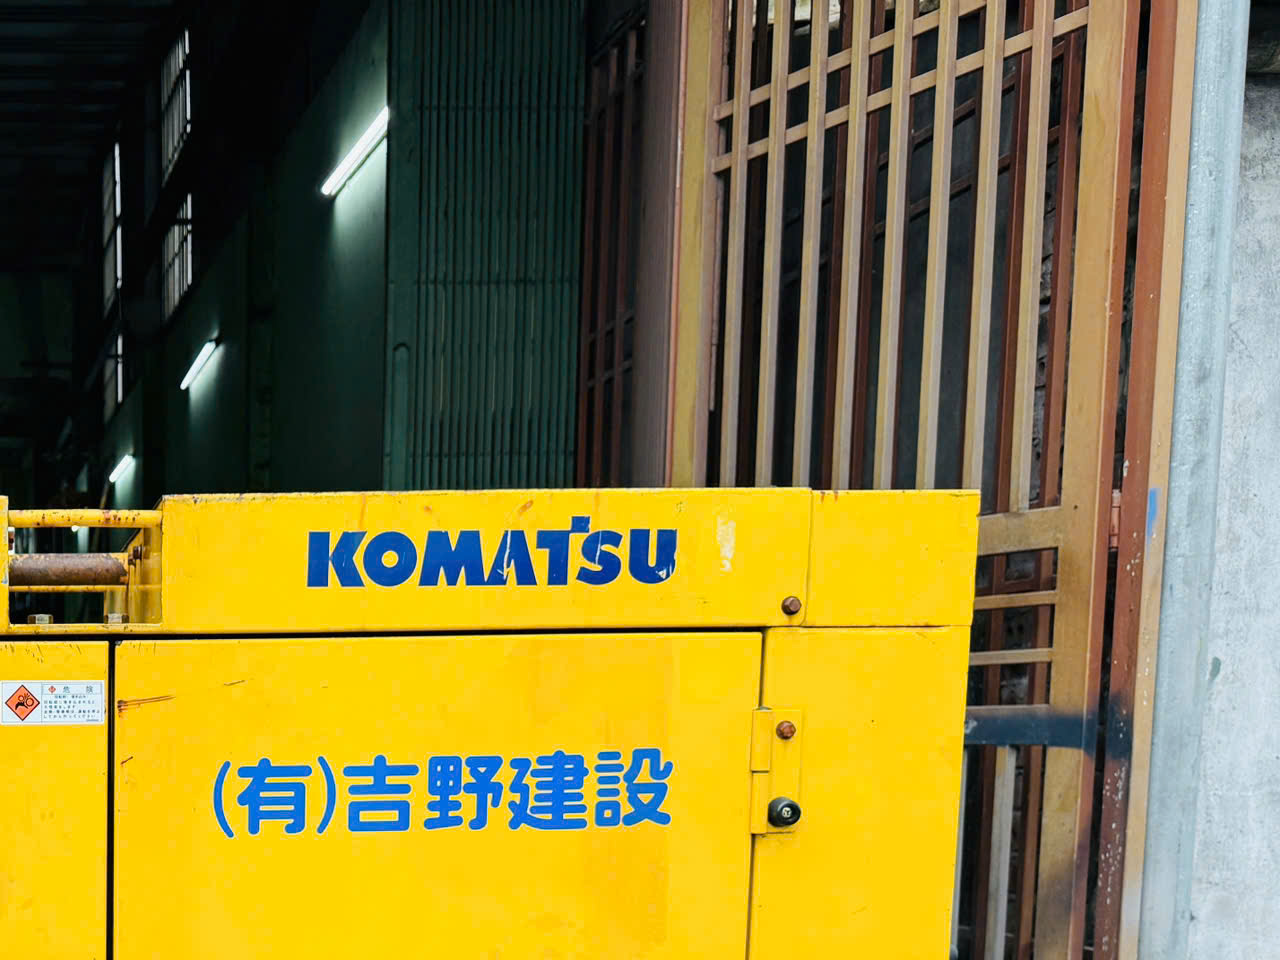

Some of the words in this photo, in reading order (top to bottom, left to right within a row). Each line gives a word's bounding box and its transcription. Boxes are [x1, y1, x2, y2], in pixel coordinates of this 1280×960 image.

[306, 516, 679, 588] KOMATSU
[213, 748, 674, 838] (有)吉野建設
